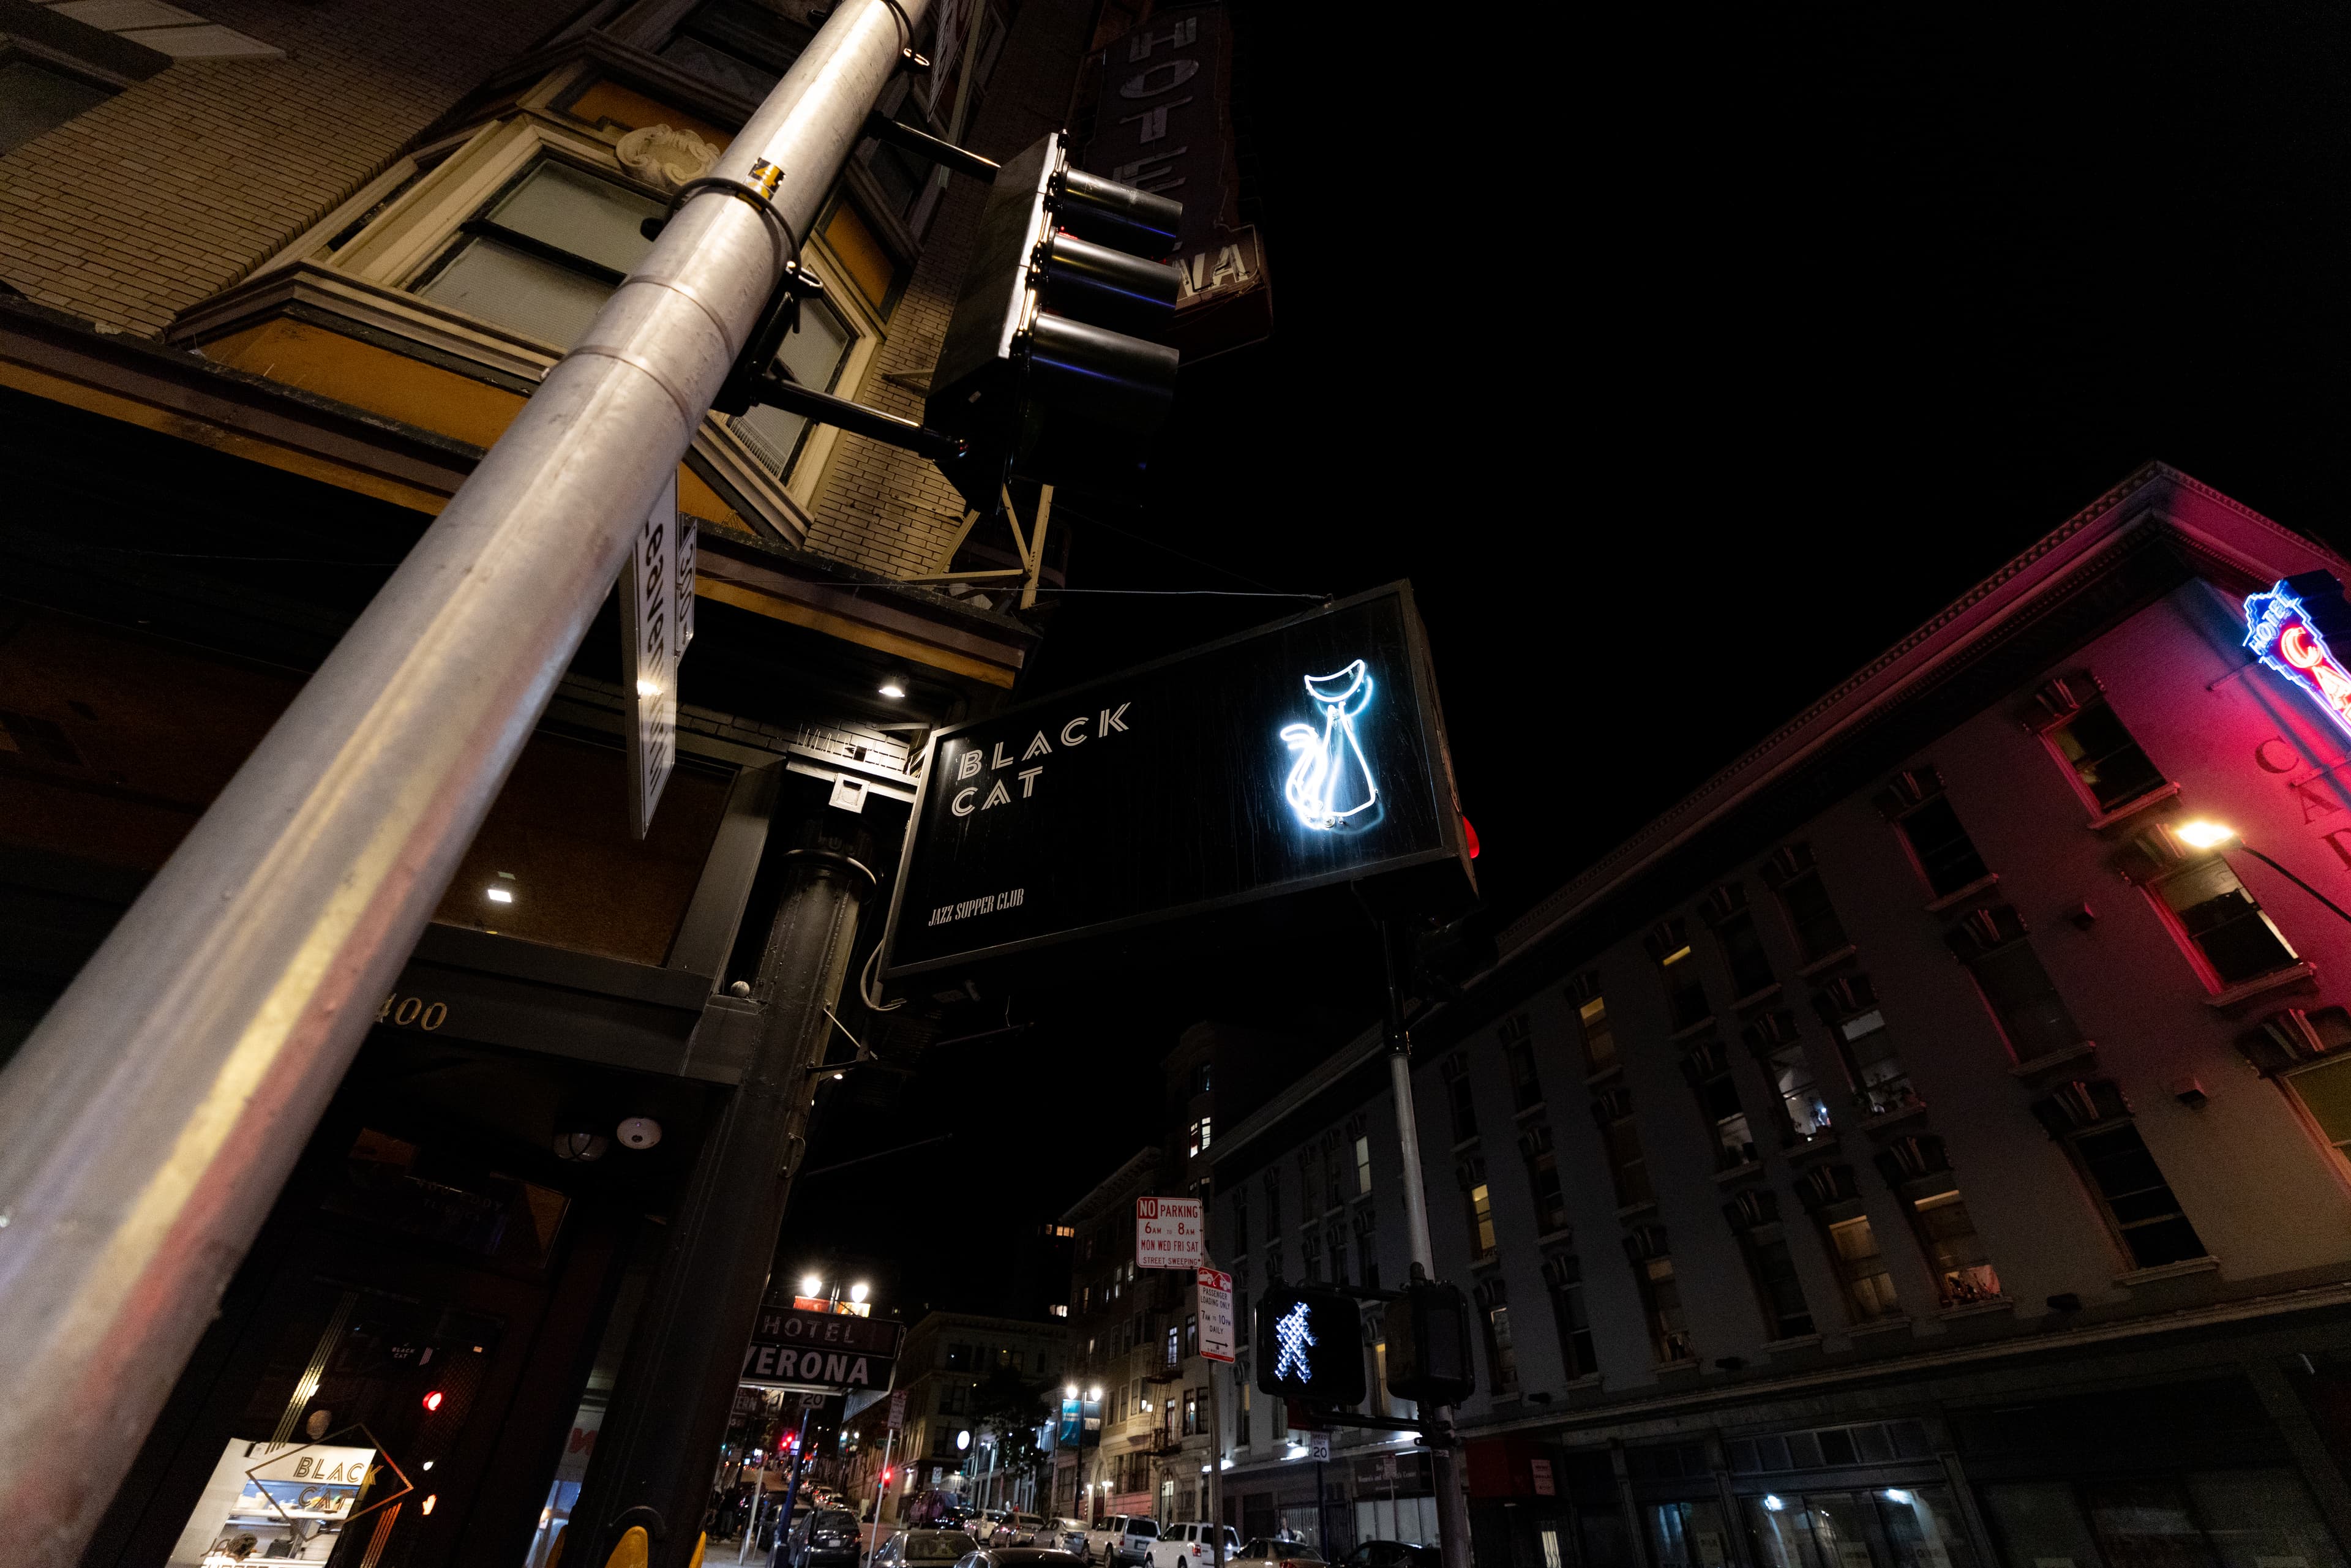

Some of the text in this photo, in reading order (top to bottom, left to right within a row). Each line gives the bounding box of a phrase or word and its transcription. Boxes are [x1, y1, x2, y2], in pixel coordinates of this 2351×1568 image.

[1112, 17, 1199, 195] HOTE
[2248, 594, 2293, 656] HOTEL
[957, 702, 1131, 781] BLACK
[951, 766, 1043, 817] CAT
[928, 888, 1024, 926] JAZZ SUPPER CLUB
[1139, 1200, 1198, 1218] NO PARKING
[1141, 1239, 1199, 1253] MON WED FRI SAT
[1201, 1296, 1231, 1310] LOADING ONLY
[1202, 1287, 1228, 1300] PASSENGER
[762, 1315, 855, 1344] HOTEL
[1209, 1325, 1224, 1335] DAILY
[803, 1394, 823, 1406] 20
[1313, 1447, 1327, 1458] 20
[293, 1456, 384, 1485] BLACK
[298, 1486, 353, 1510] CAT
